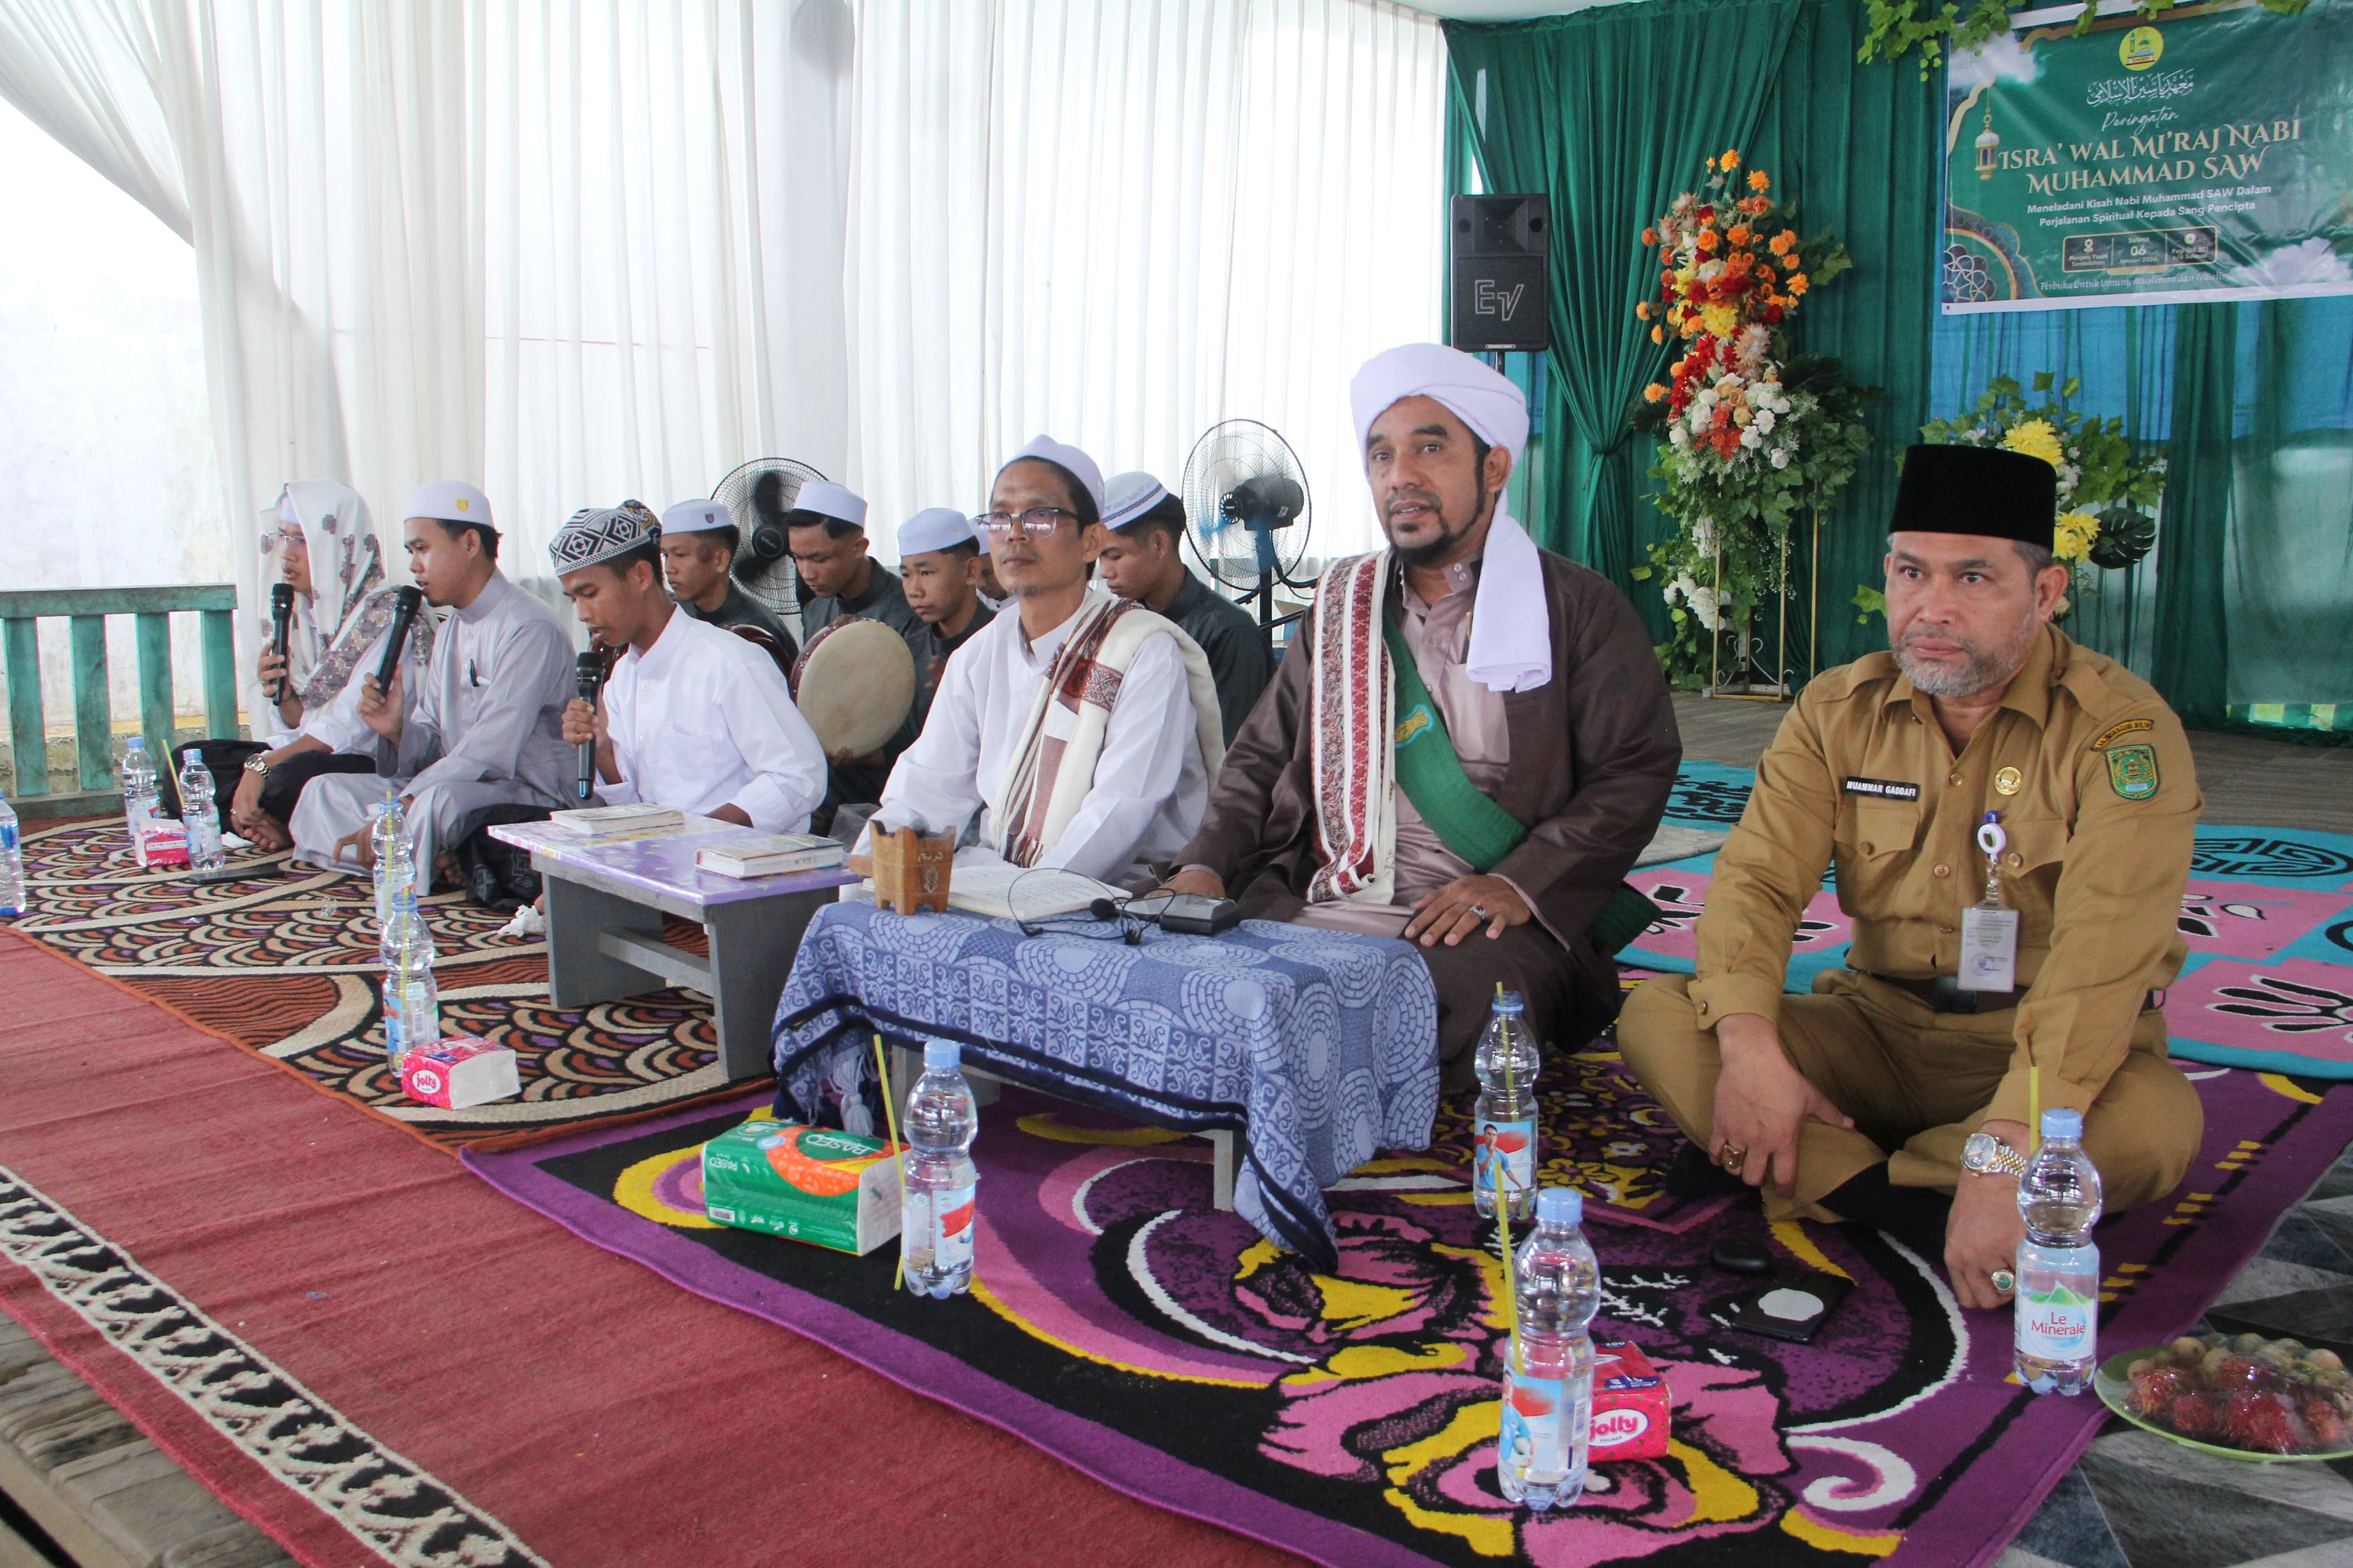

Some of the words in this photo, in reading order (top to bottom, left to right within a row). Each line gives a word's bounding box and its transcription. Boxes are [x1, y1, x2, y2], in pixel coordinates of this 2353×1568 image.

[2101, 106, 2179, 136] Peringatan
[2070, 139, 2125, 162] WAL
[2223, 119, 2300, 148] NABI
[2026, 159, 2196, 196] MUHAMMAD
[2201, 145, 2270, 180] SAW
[2027, 201, 2084, 214] Meneladani
[2087, 198, 2113, 209] Kisah
[2115, 196, 2140, 206] Nabi
[2143, 190, 2207, 204] Muhammad
[2207, 187, 2234, 198] SAW
[2236, 184, 2271, 196] Dalam
[2040, 215, 2090, 227] Perjalanan
[2093, 211, 2134, 224] Spiritual
[2136, 206, 2175, 219] Kepada
[2178, 205, 2204, 216] Sang
[2208, 201, 2256, 213] Pencipta
[2130, 245, 2147, 256] 06
[1846, 781, 1884, 793] MUAMMAR
[1885, 785, 1916, 797] GADDAFI
[417, 1073, 437, 1088] jolly
[805, 1134, 870, 1155] PASEO
[709, 1156, 738, 1172] PASEO
[2031, 1319, 2086, 1335] Minerale
[2050, 1311, 2067, 1324] Le
[1589, 1415, 1638, 1442] jolly
